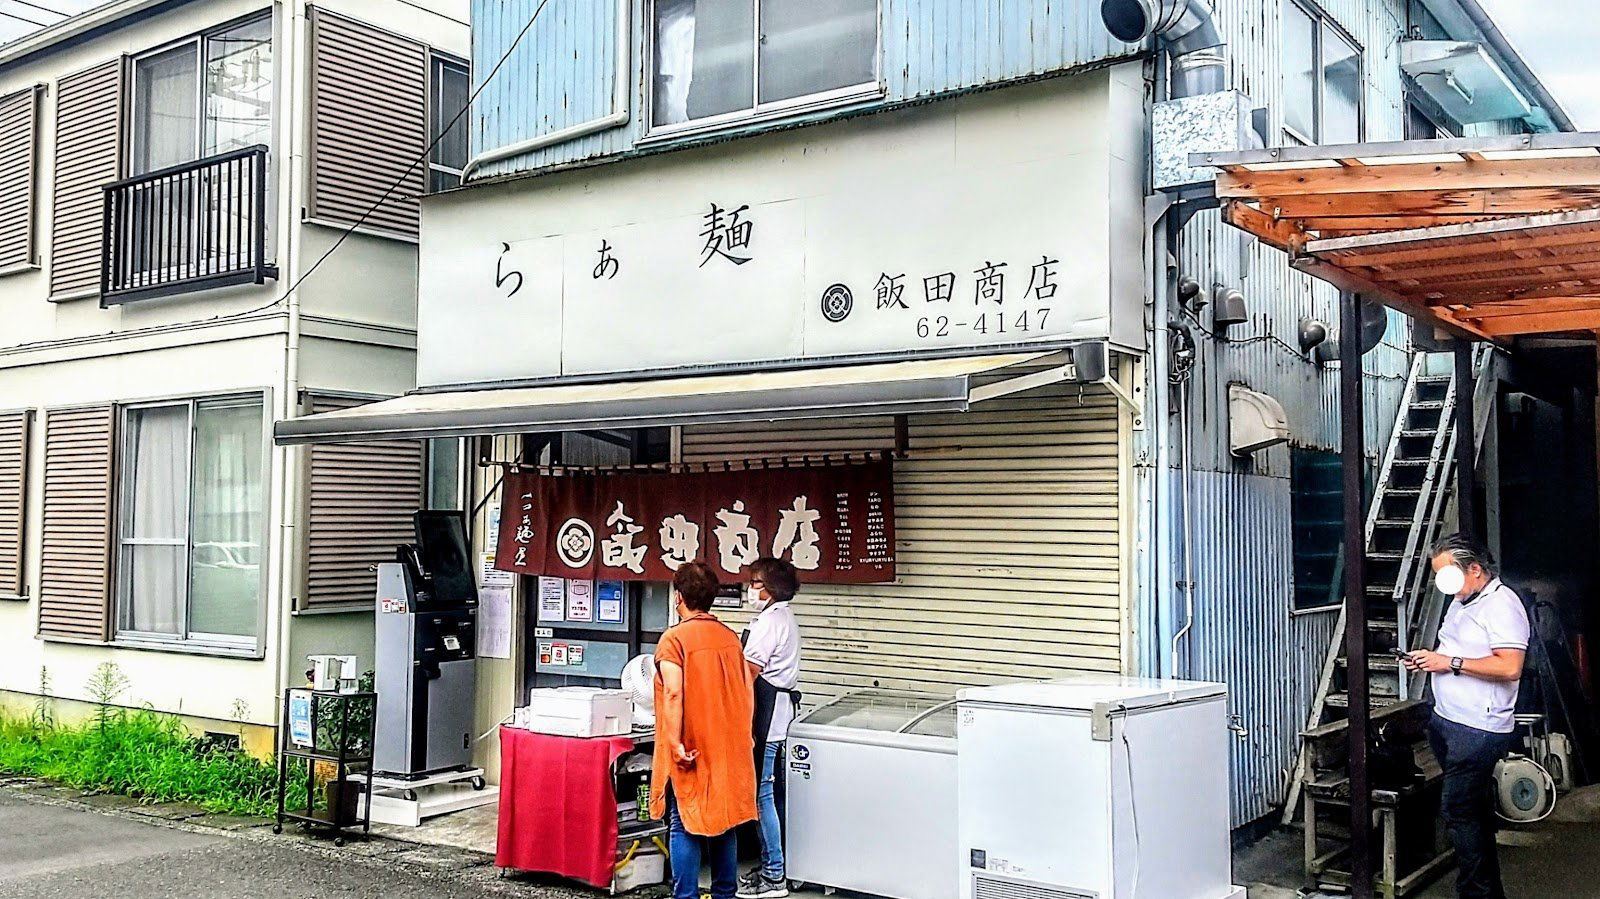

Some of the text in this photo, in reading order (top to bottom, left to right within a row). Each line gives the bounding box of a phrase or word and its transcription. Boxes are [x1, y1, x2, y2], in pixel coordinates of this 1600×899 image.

[873, 255, 1060, 310] 飯田商店
[916, 308, 1051, 338] 62-4147
[600, 495, 822, 574] 飯田商店
